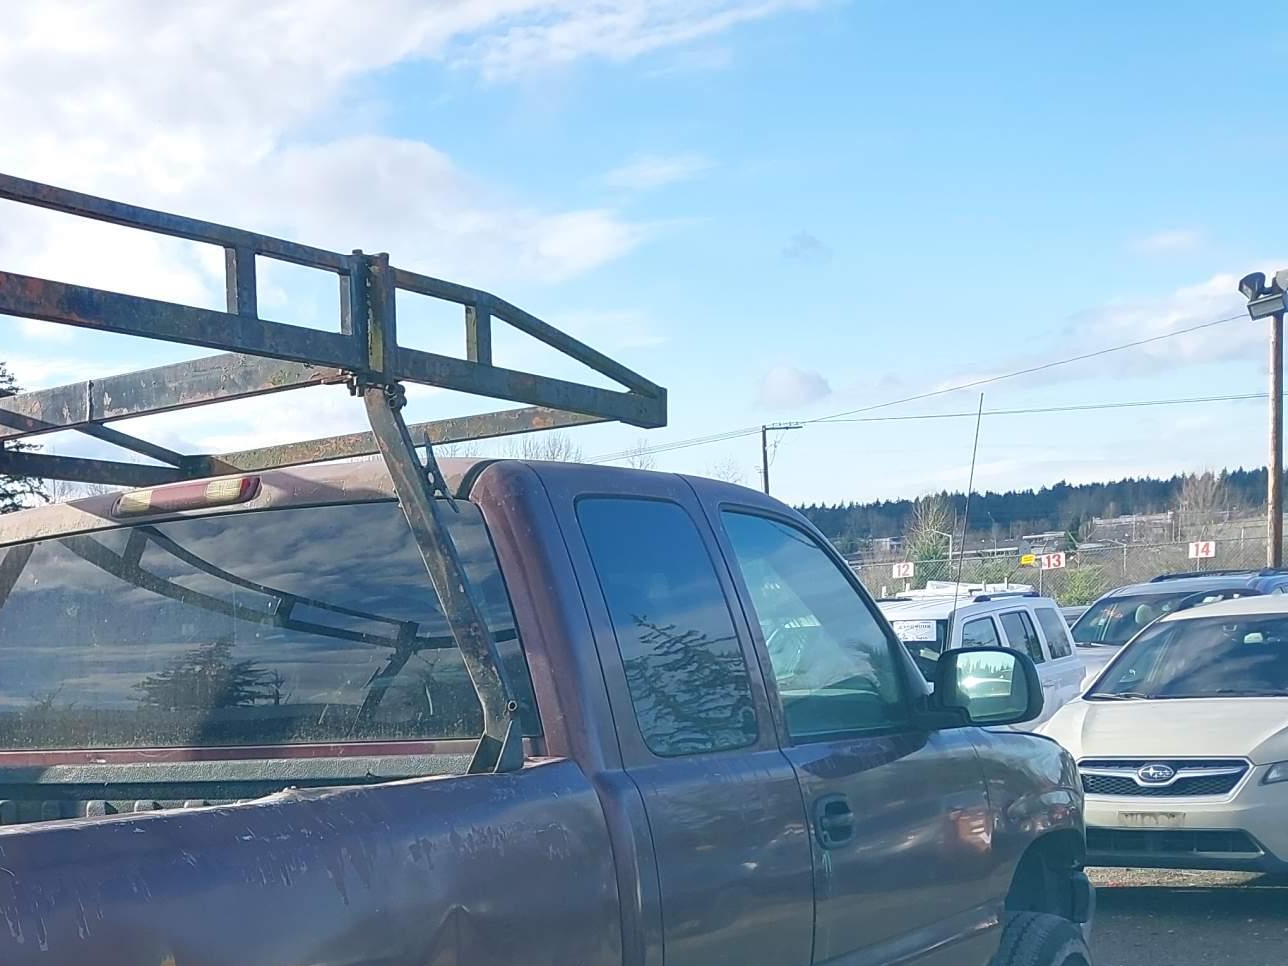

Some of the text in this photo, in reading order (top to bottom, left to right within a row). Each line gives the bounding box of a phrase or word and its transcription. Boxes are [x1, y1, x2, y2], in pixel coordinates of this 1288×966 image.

[1193, 542, 1211, 557] 14
[1045, 553, 1062, 569] 13
[896, 563, 911, 577] 12
